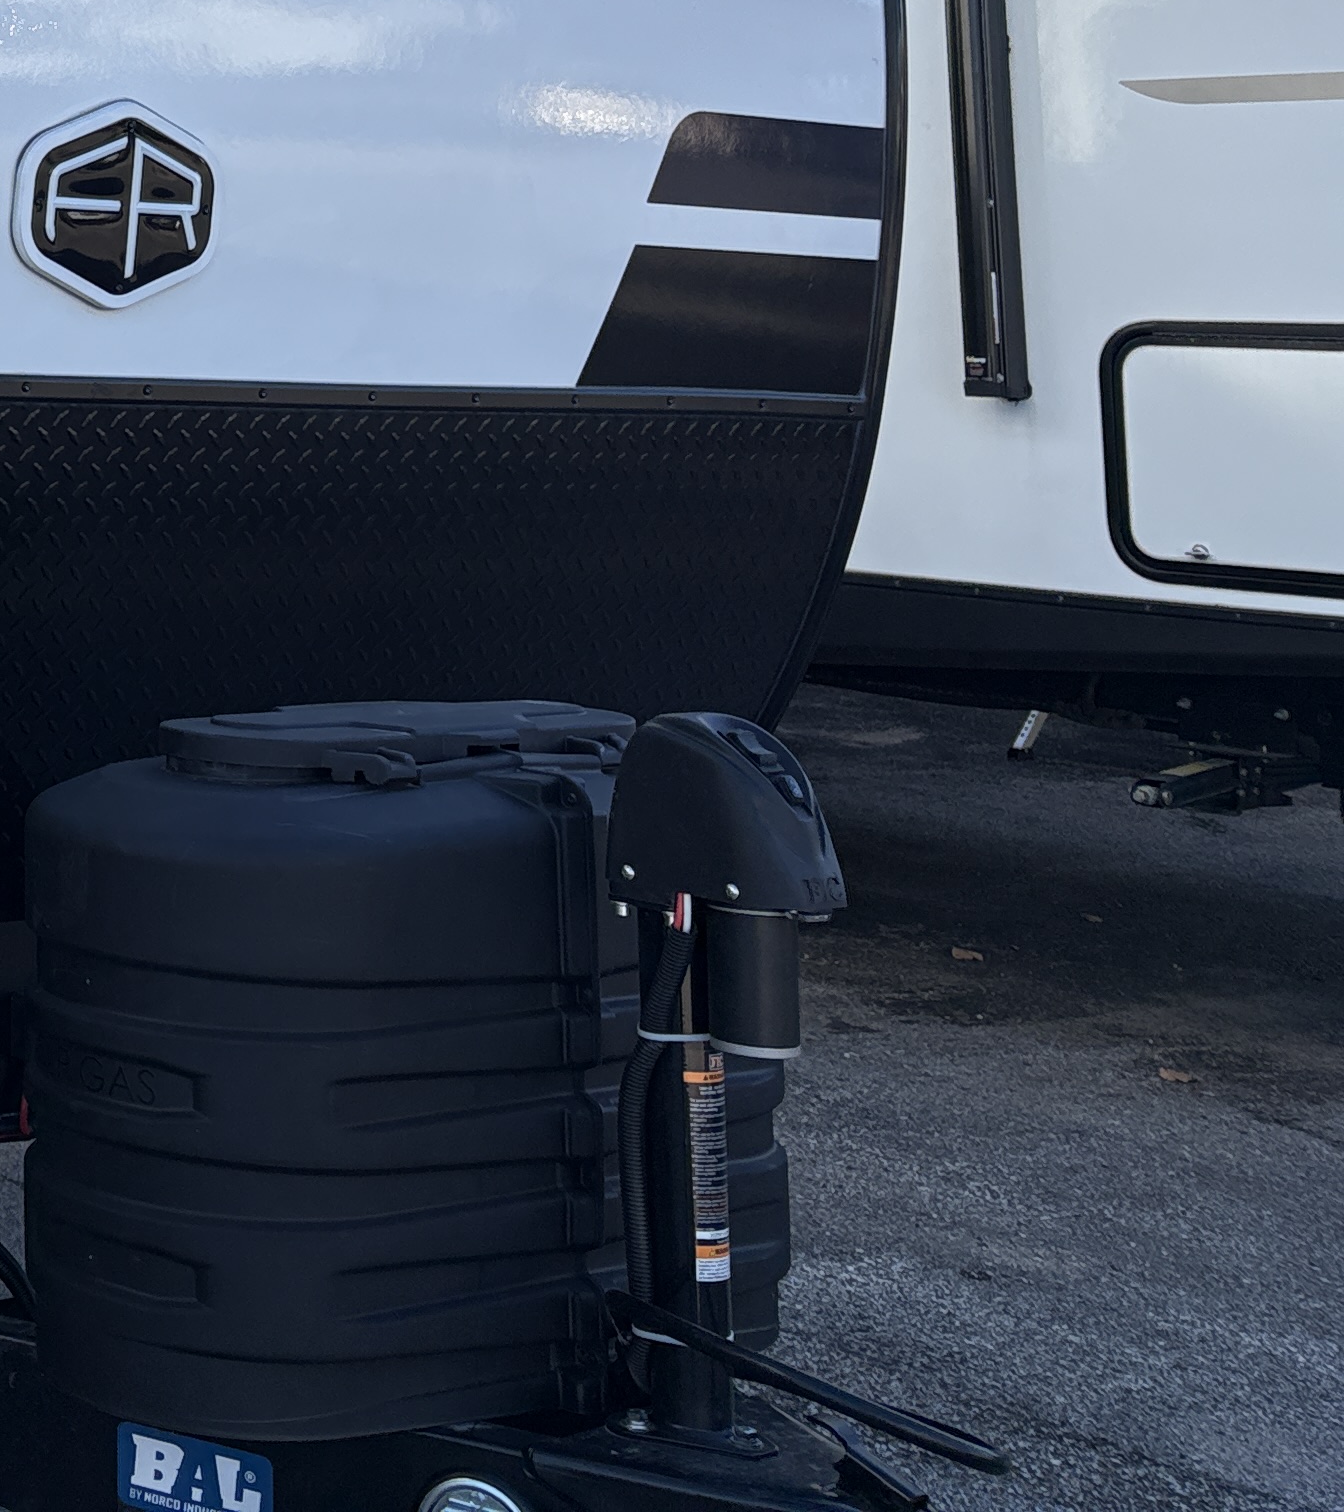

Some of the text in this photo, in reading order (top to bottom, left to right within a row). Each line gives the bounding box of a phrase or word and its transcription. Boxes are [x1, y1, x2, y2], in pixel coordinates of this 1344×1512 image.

[79, 1055, 157, 1106] GAS
[129, 1486, 142, 1500] BY
[144, 1491, 181, 1510] NORCO
